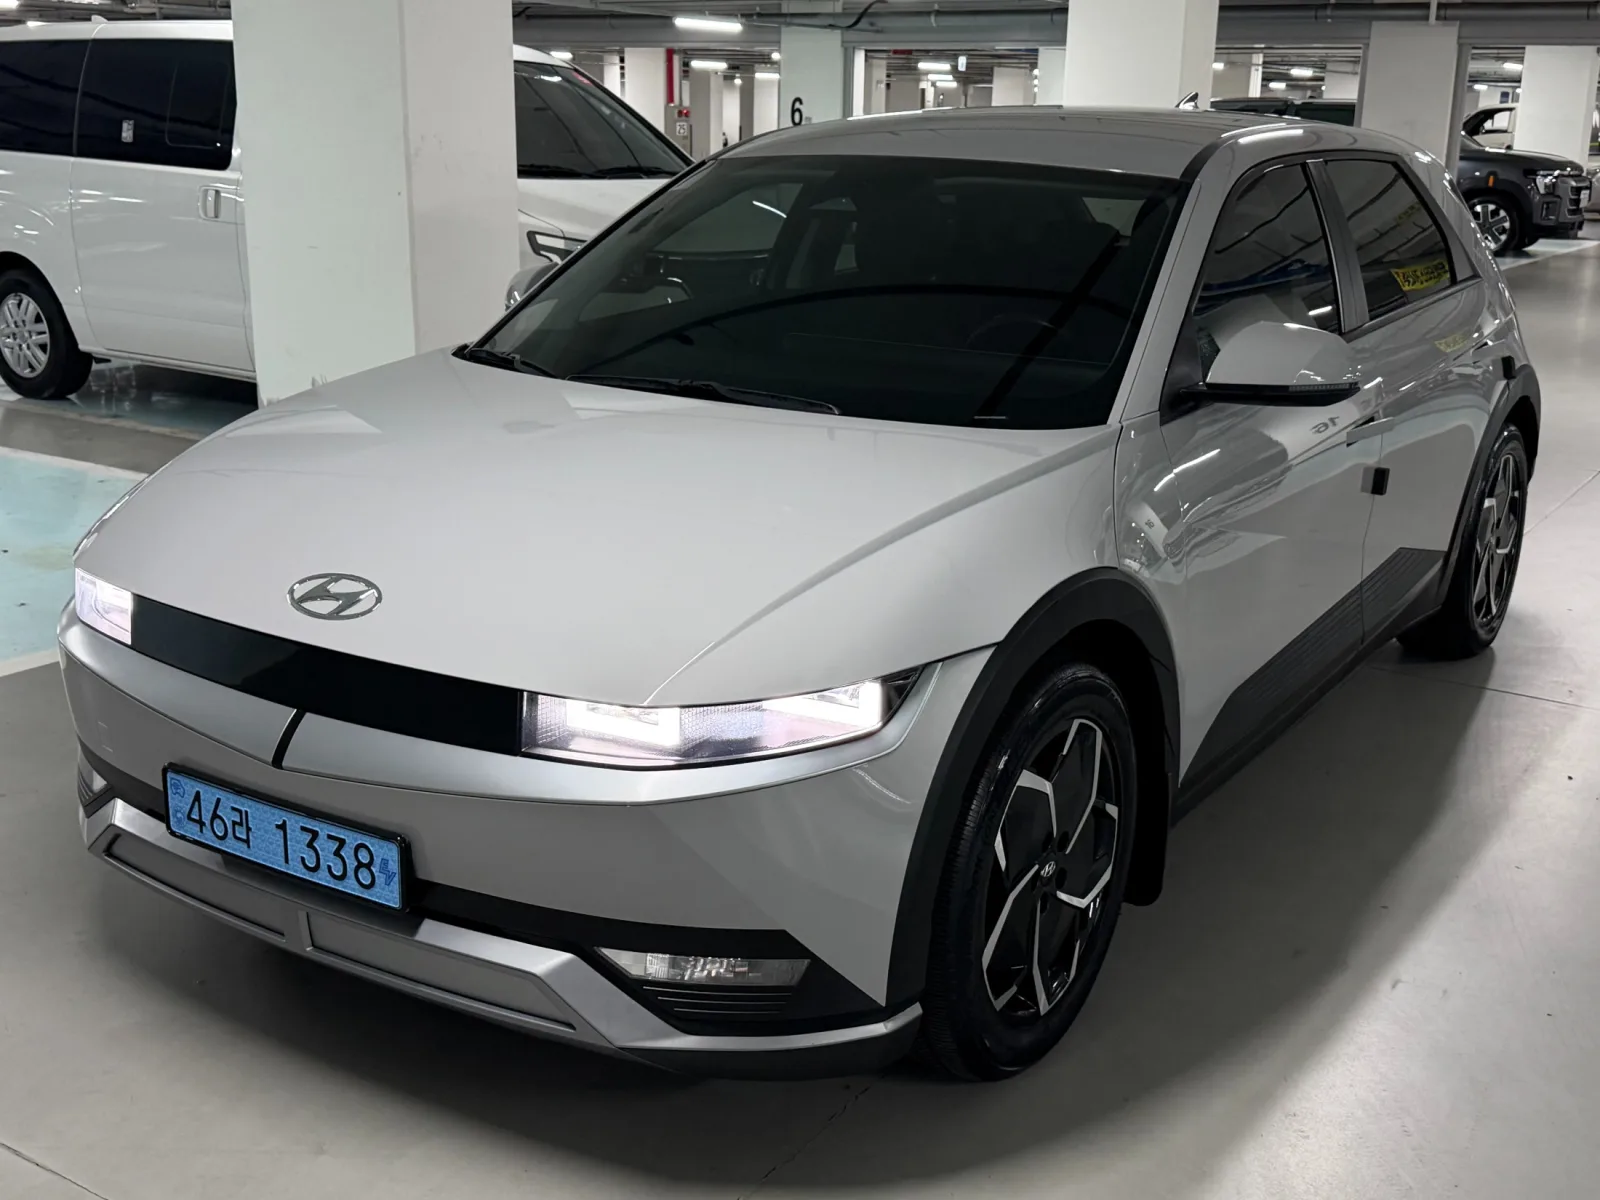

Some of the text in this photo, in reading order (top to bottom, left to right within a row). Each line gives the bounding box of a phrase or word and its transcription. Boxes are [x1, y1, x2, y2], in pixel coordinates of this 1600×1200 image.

[791, 97, 804, 126] 6
[186, 789, 376, 890] 46라 1338
[378, 858, 396, 886] EV
